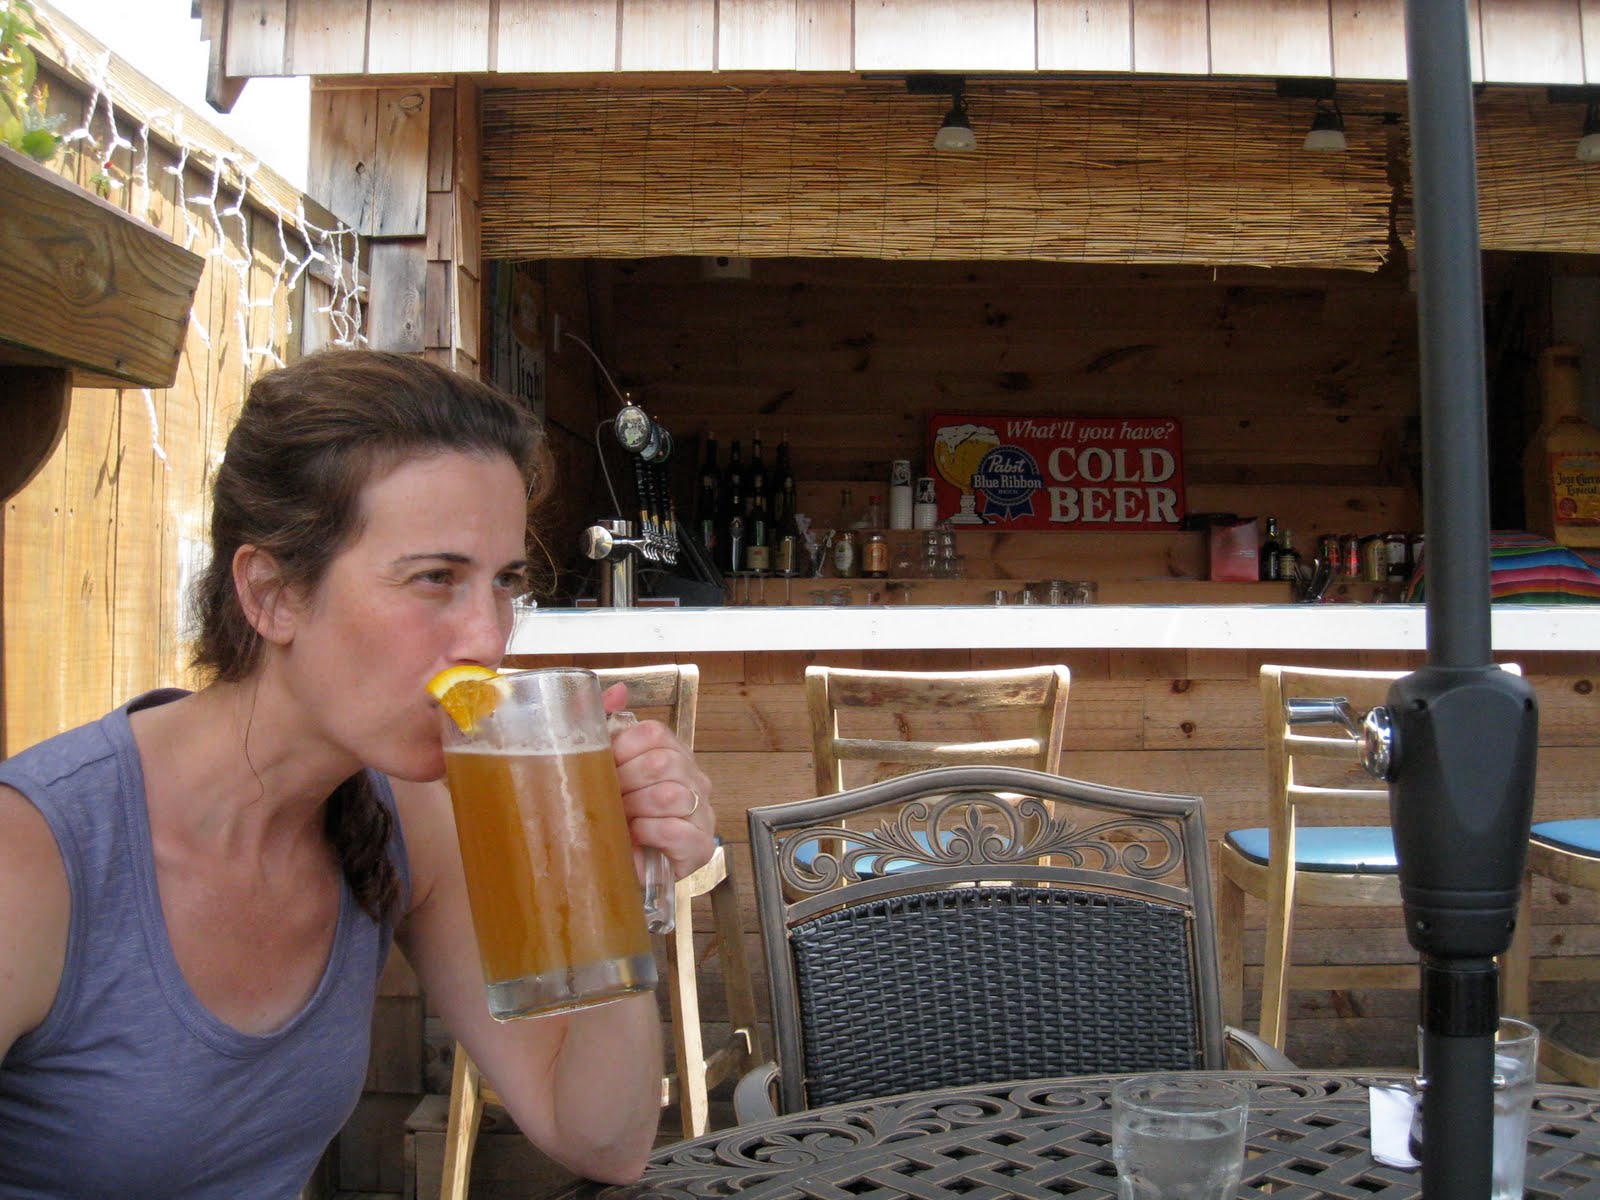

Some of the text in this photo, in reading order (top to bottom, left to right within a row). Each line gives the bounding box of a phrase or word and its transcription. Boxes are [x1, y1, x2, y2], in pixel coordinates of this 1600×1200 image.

[1006, 420, 1175, 443] What'll you have?
[988, 454, 1027, 473] Pabst
[1047, 447, 1175, 483] COLD
[973, 474, 1042, 489] Blue Ribbon
[1047, 486, 1180, 523] BEER
